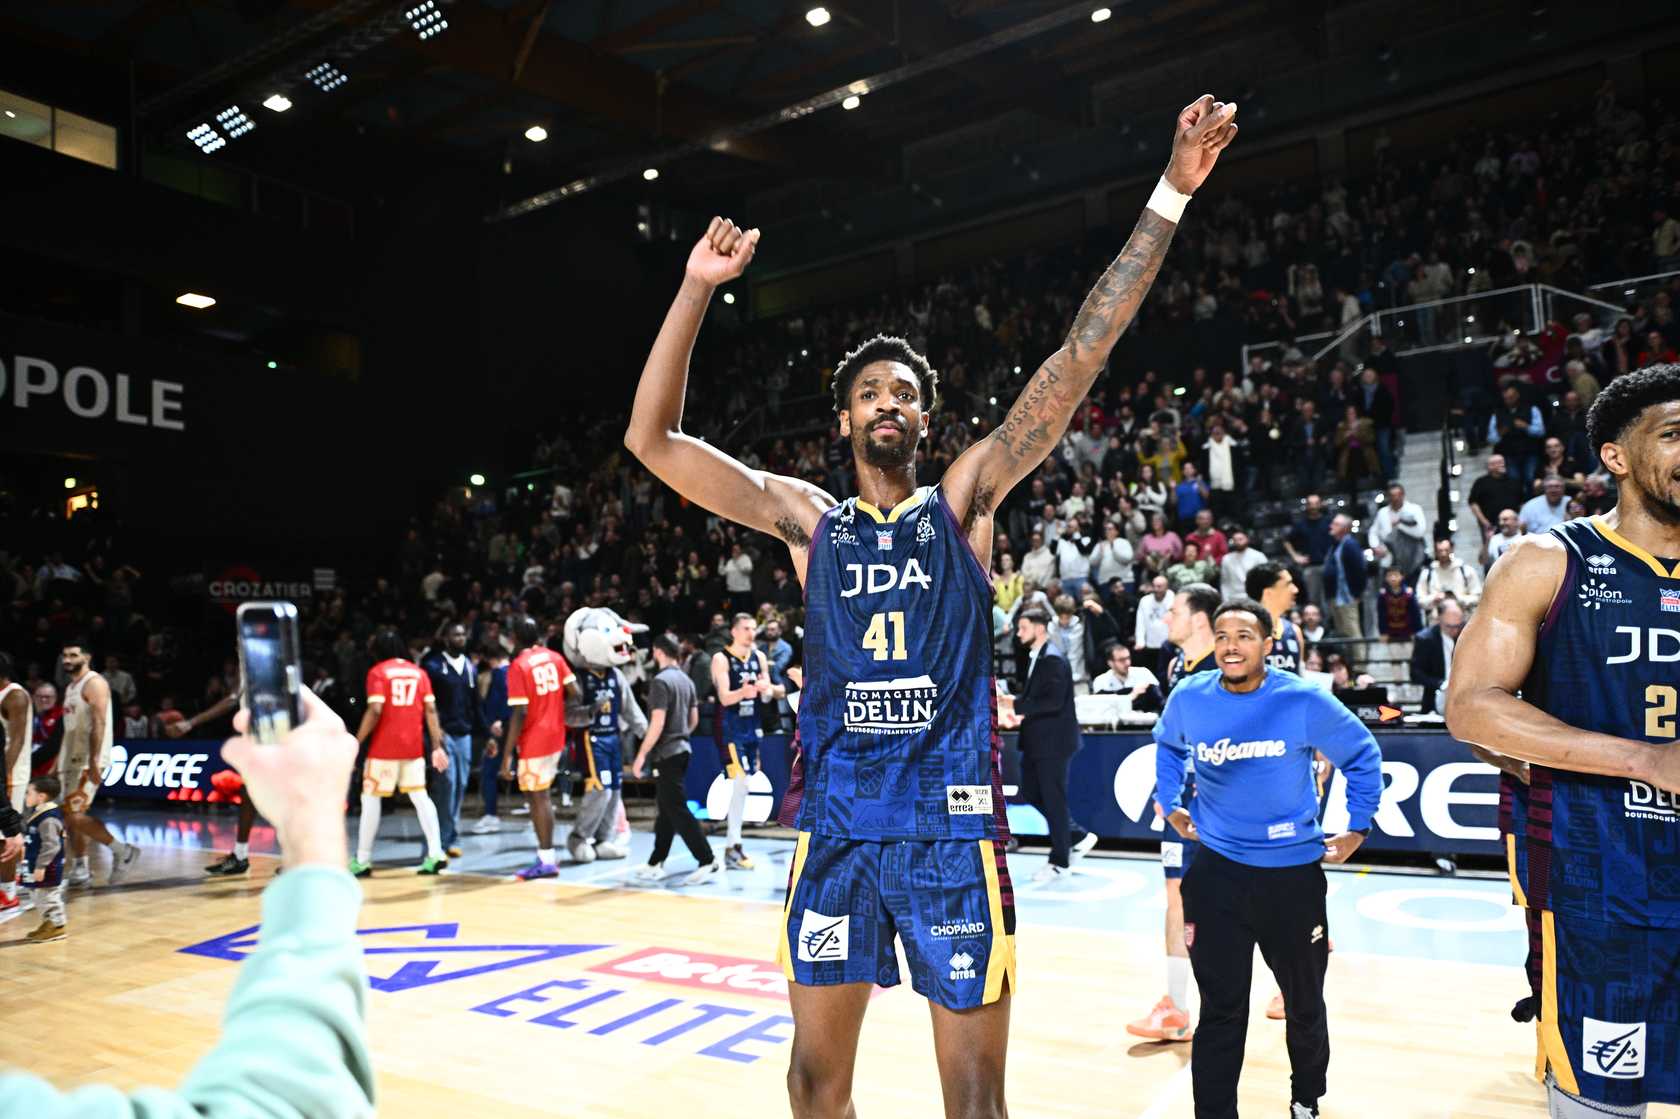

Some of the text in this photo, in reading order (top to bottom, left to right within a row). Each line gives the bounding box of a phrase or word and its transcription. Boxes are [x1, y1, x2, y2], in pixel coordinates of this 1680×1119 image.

[0, 355, 185, 431] POLE
[840, 558, 932, 598] JDA
[1588, 566, 1617, 575] errea
[209, 581, 312, 598] CROZATIER
[862, 611, 908, 661] 41
[1606, 626, 1680, 665] JD
[391, 679, 418, 707] 97
[531, 663, 560, 697] 99
[845, 688, 938, 701] FROMAGERIE
[847, 700, 933, 722] DELIN
[1645, 684, 1677, 738] 2
[125, 753, 208, 788] GREE
[950, 804, 974, 812] errea
[1320, 761, 1502, 841] RE
[931, 922, 985, 937] CHOPARD
